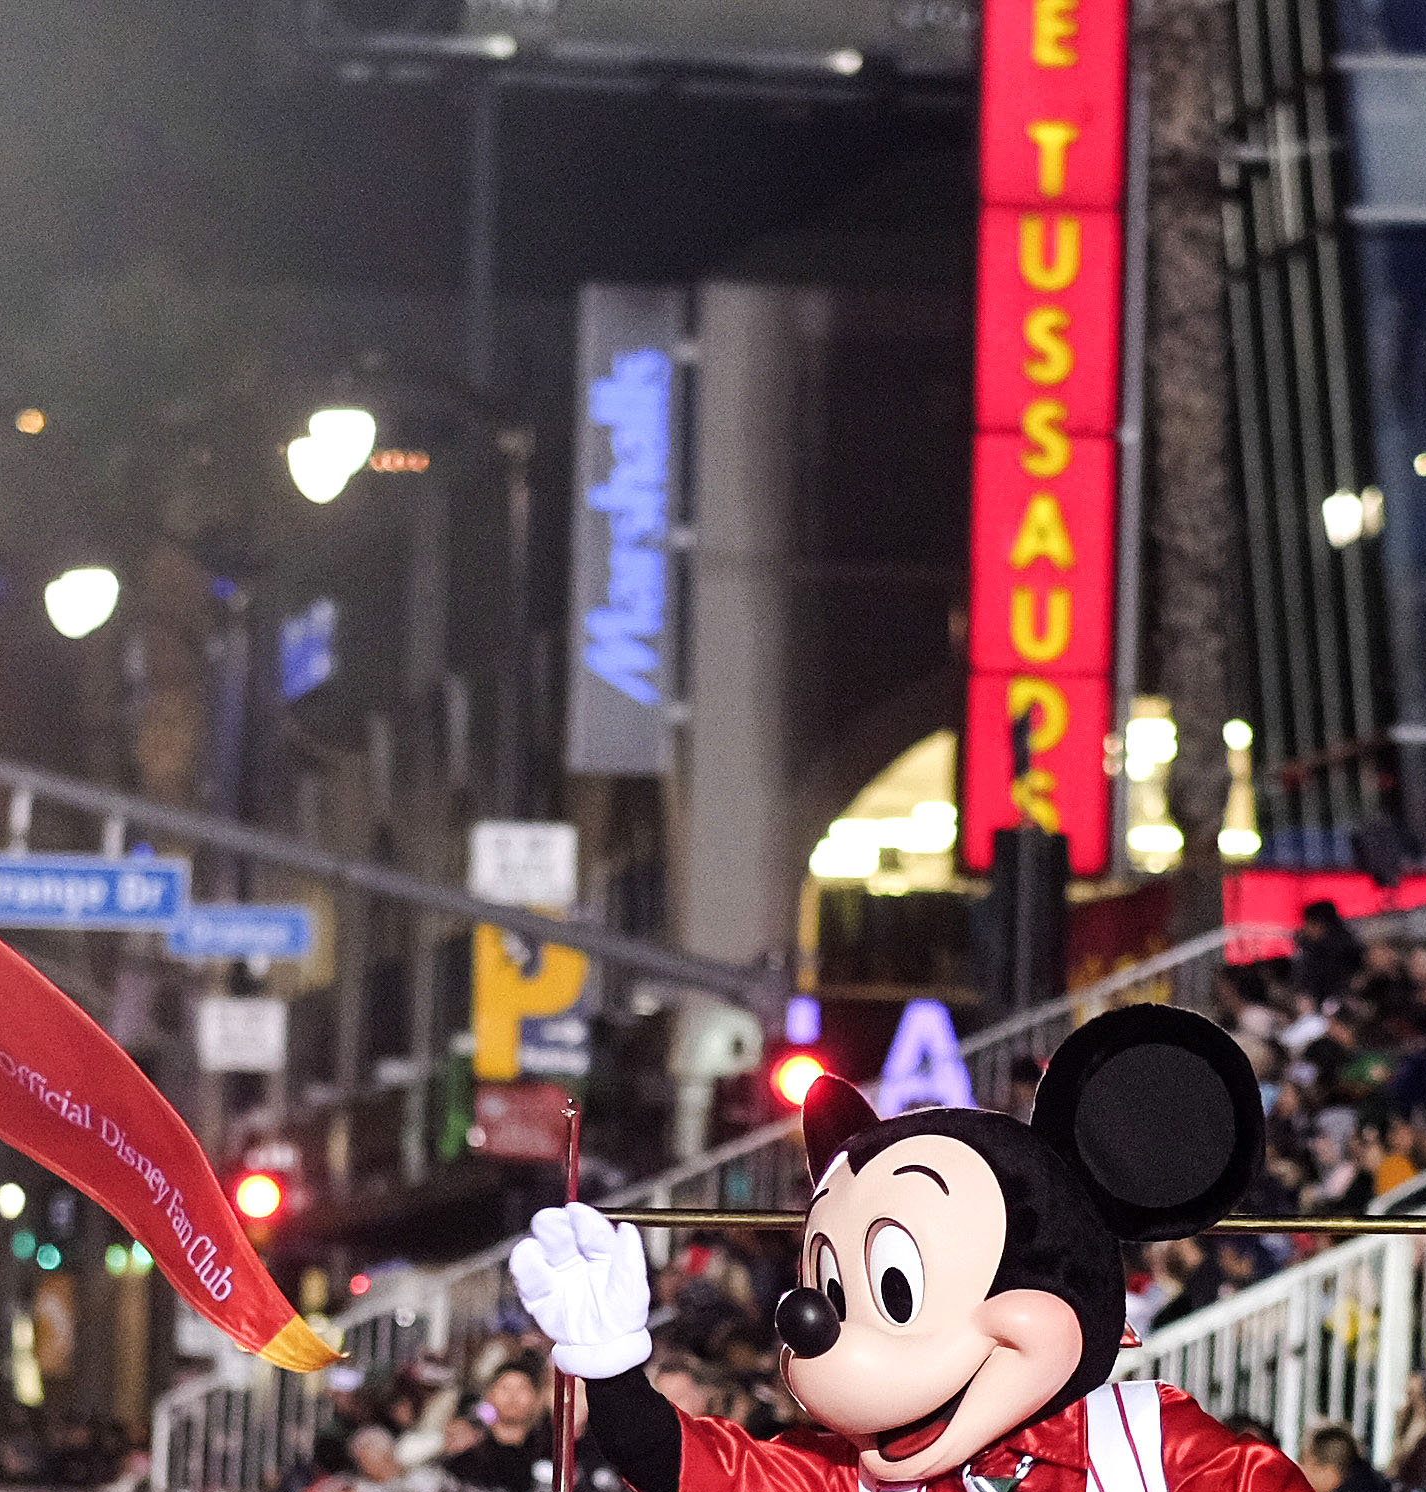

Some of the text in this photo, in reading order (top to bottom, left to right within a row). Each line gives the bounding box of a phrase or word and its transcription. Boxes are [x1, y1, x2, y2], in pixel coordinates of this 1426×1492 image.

[1008, 121, 1080, 836] TUSSAUDS
[117, 866, 166, 911] Dr
[100, 1115, 172, 1205] Disney
[165, 1187, 194, 1249] Fan
[186, 1234, 233, 1302] Club
